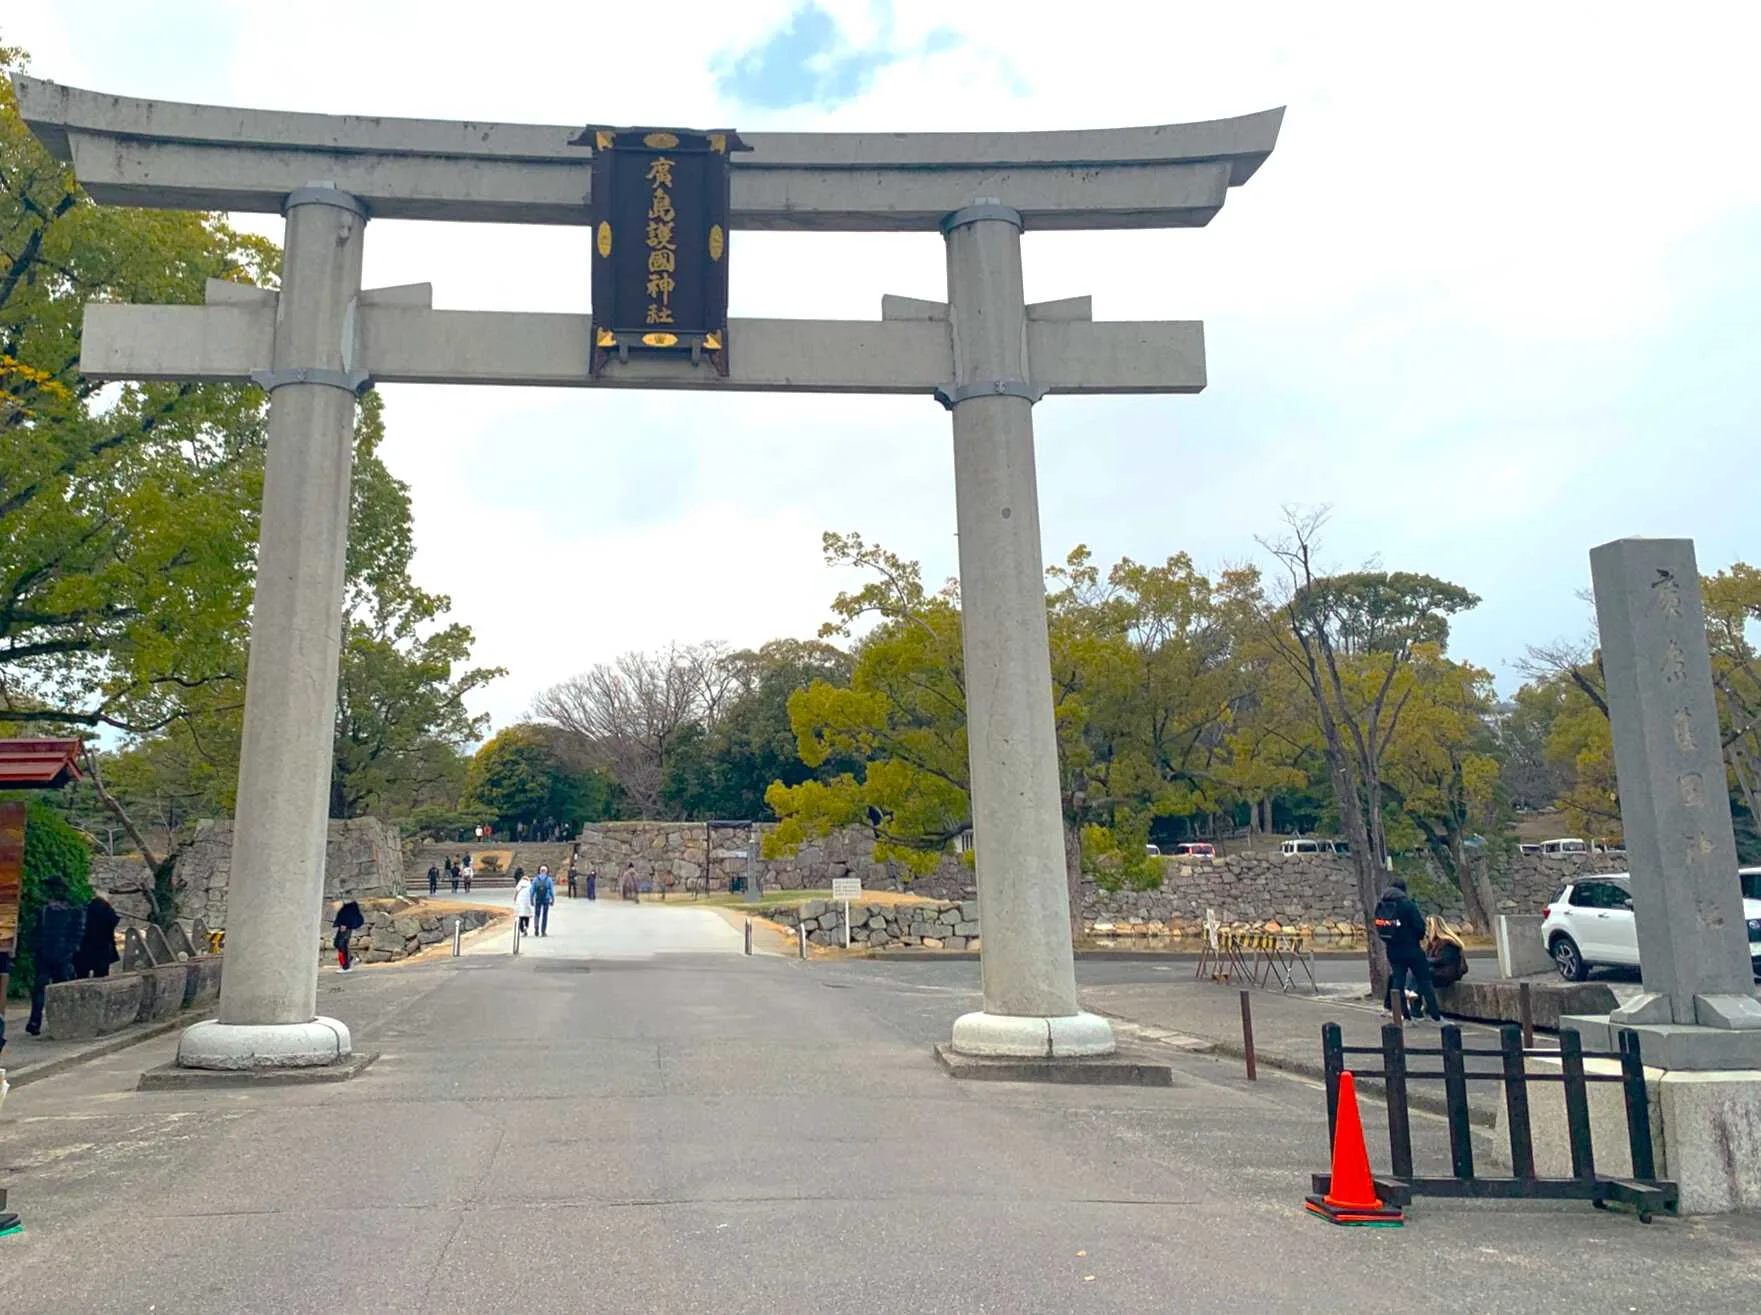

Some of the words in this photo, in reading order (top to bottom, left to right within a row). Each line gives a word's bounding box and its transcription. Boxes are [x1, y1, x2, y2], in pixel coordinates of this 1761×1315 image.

[645, 156, 677, 324] 廣島護國神社
